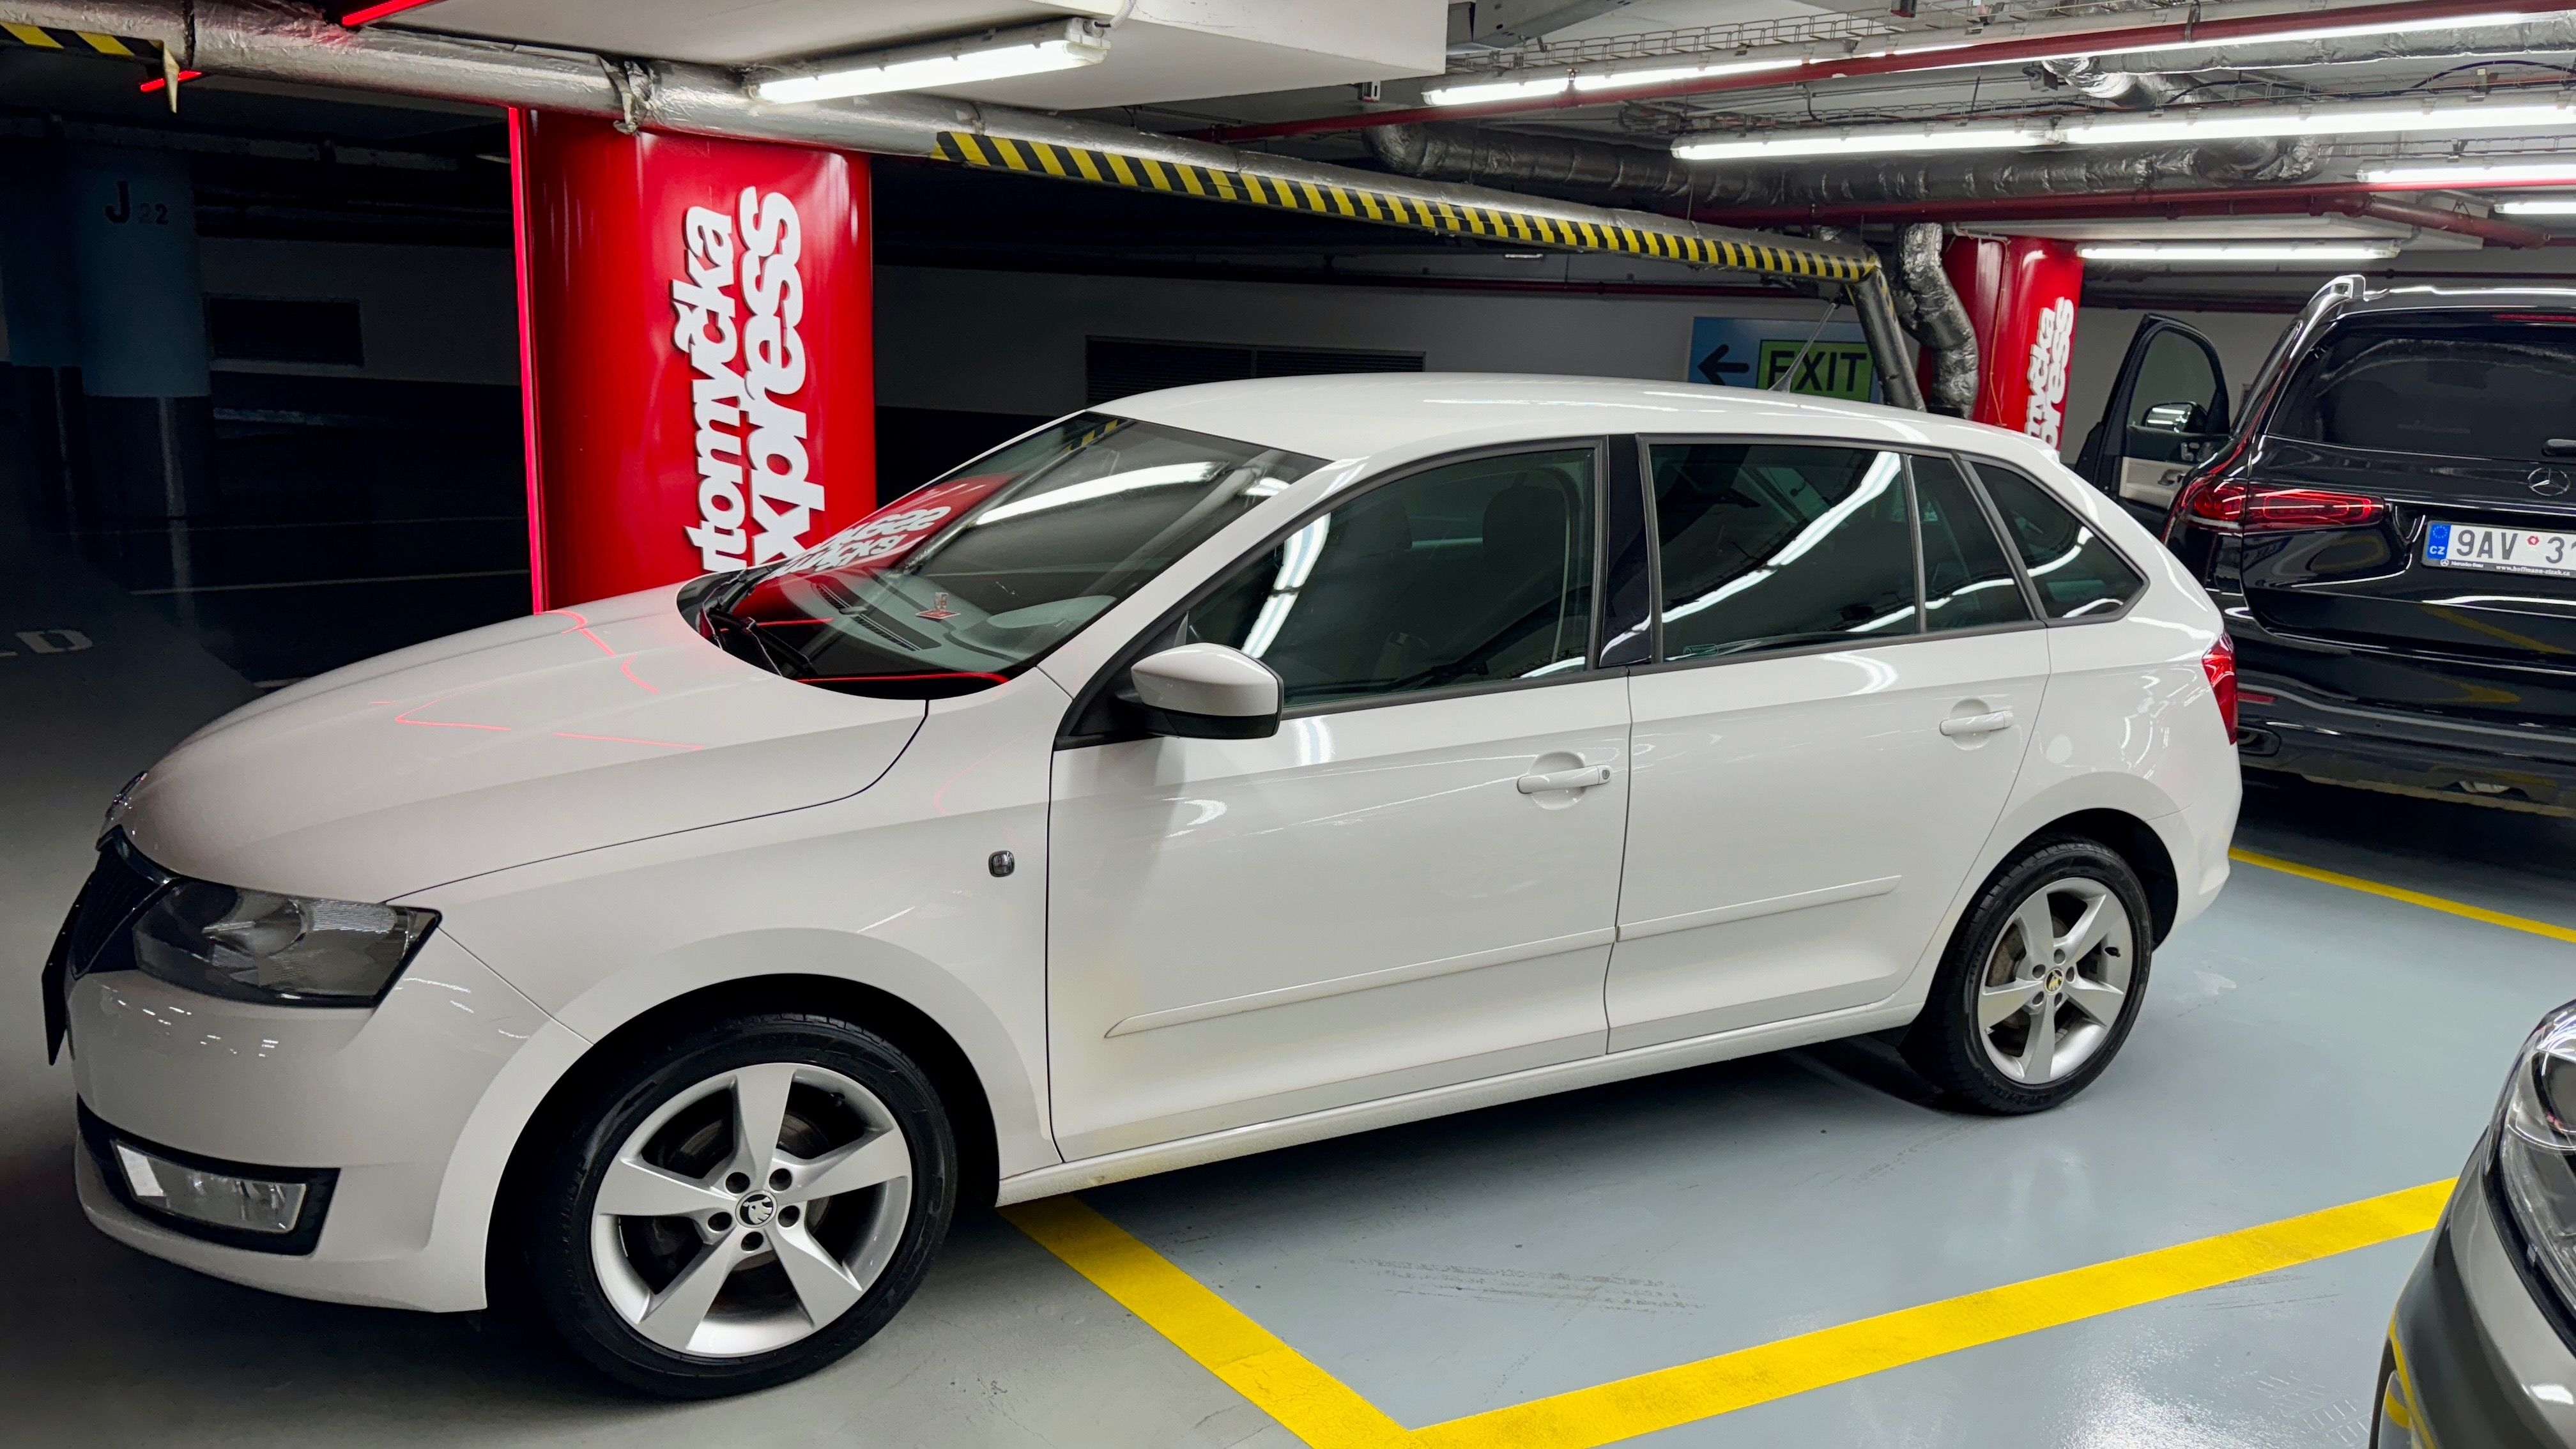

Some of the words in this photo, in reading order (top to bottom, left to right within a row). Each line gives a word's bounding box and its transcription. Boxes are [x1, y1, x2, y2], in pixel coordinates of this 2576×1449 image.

[671, 206, 747, 572] tomyčka
[739, 186, 825, 567] xpress
[1767, 350, 1867, 392] EXIT
[2429, 545, 2446, 555] CZ
[2457, 529, 2518, 560] 9AV
